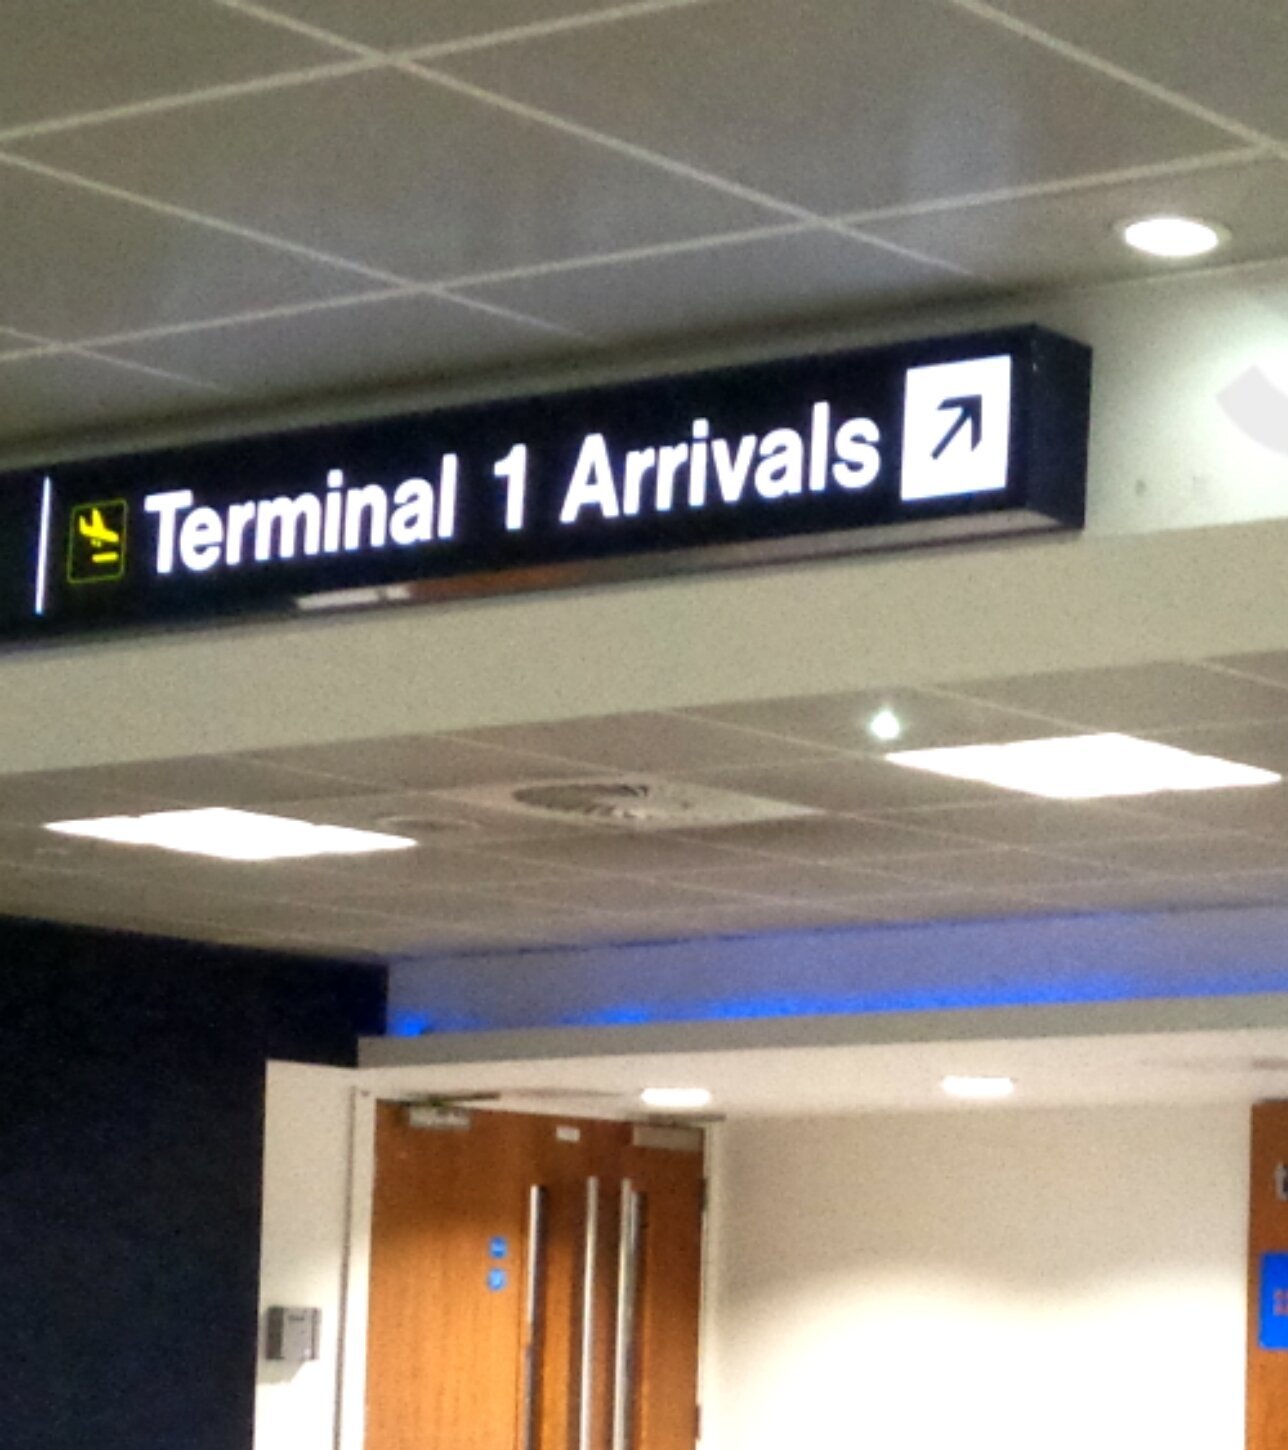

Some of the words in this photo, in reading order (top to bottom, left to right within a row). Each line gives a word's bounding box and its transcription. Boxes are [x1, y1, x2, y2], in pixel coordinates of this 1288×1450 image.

[142, 453, 458, 575] Terminal
[491, 444, 530, 532] 1
[559, 401, 881, 525] Arrivals
